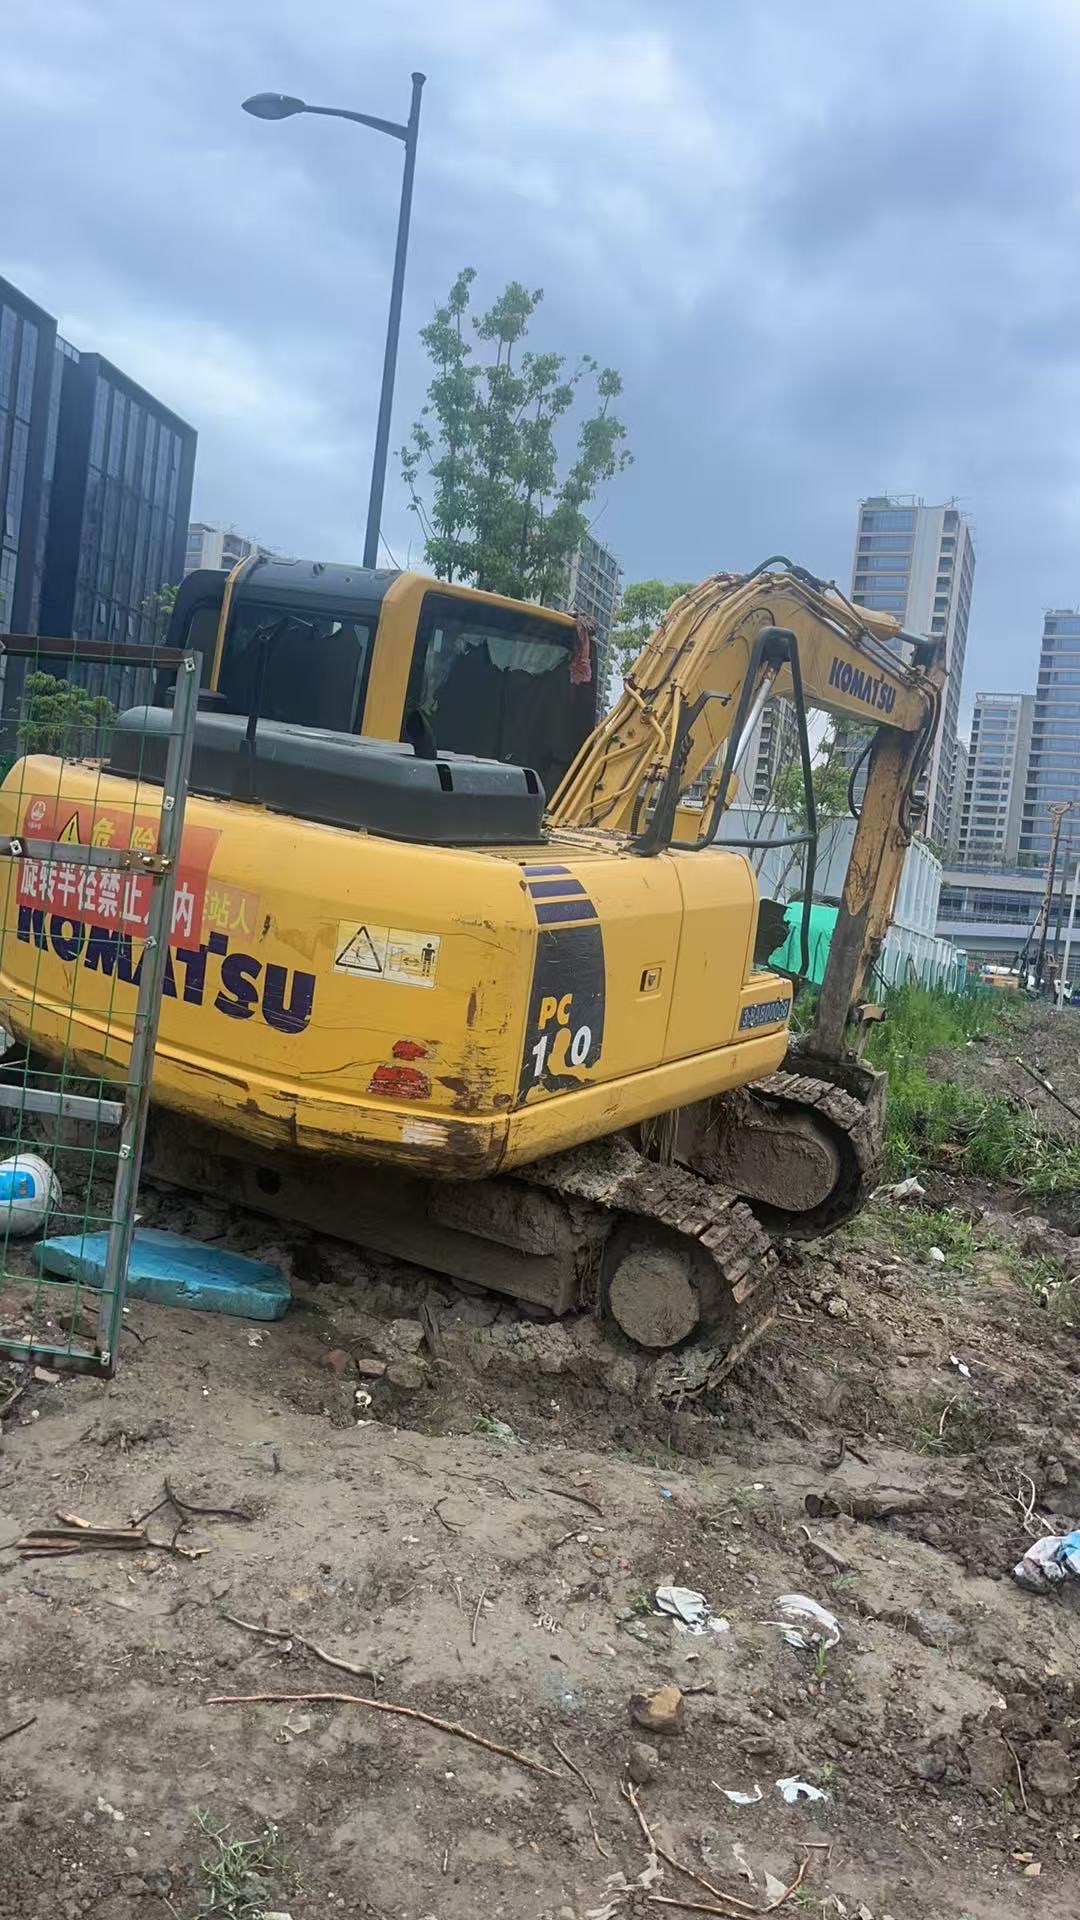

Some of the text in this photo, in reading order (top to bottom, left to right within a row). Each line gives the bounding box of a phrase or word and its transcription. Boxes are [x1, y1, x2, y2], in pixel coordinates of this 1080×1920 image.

[830, 658, 896, 713] KOMATSU
[20, 858, 195, 937] 旋转半径禁止内
[203, 890, 249, 934] 站人
[538, 993, 573, 1030] PC
[532, 1025, 592, 1077] 10
